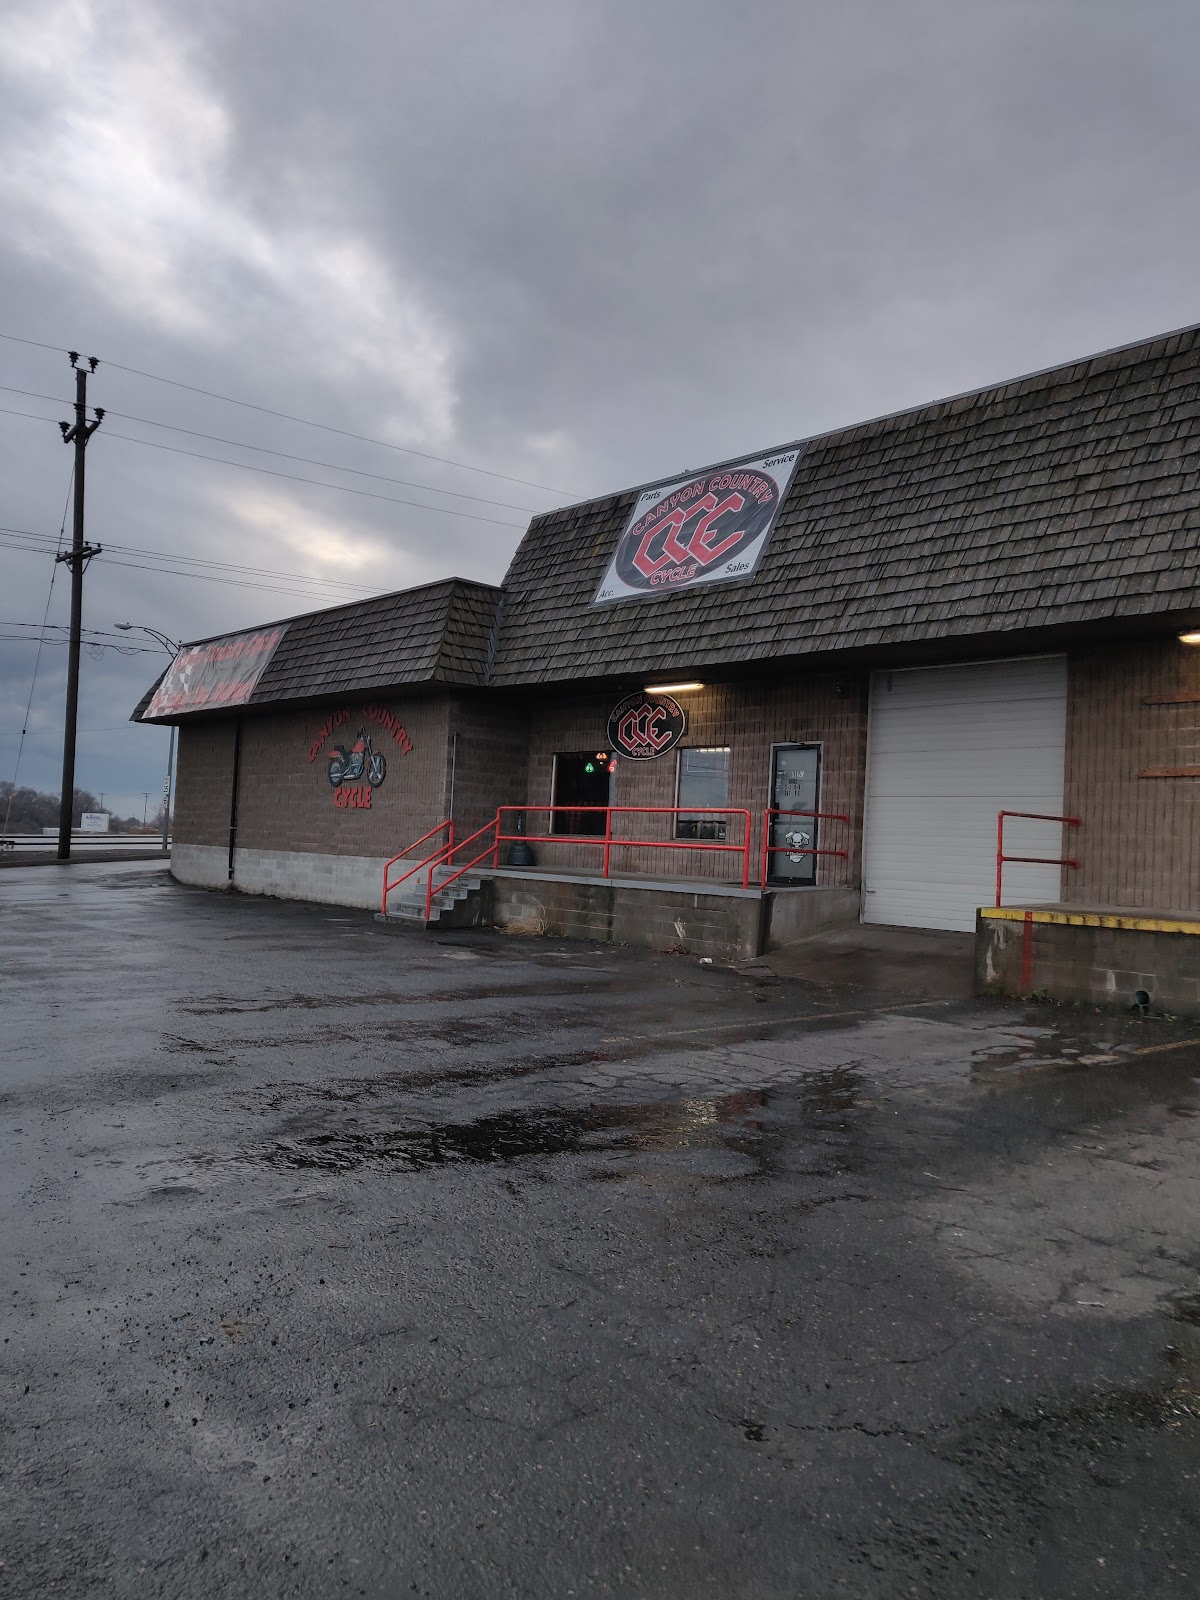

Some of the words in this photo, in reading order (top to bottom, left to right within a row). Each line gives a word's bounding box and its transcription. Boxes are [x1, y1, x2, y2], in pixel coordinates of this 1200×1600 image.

[763, 454, 795, 469] Service
[641, 490, 661, 502] Parts
[633, 481, 705, 535] CANYON
[708, 474, 773, 505] COUNTRY
[650, 563, 699, 586] CYCLE
[725, 562, 750, 574] Sales
[632, 747, 655, 757] CYCLE
[334, 786, 372, 809] CYCLE
